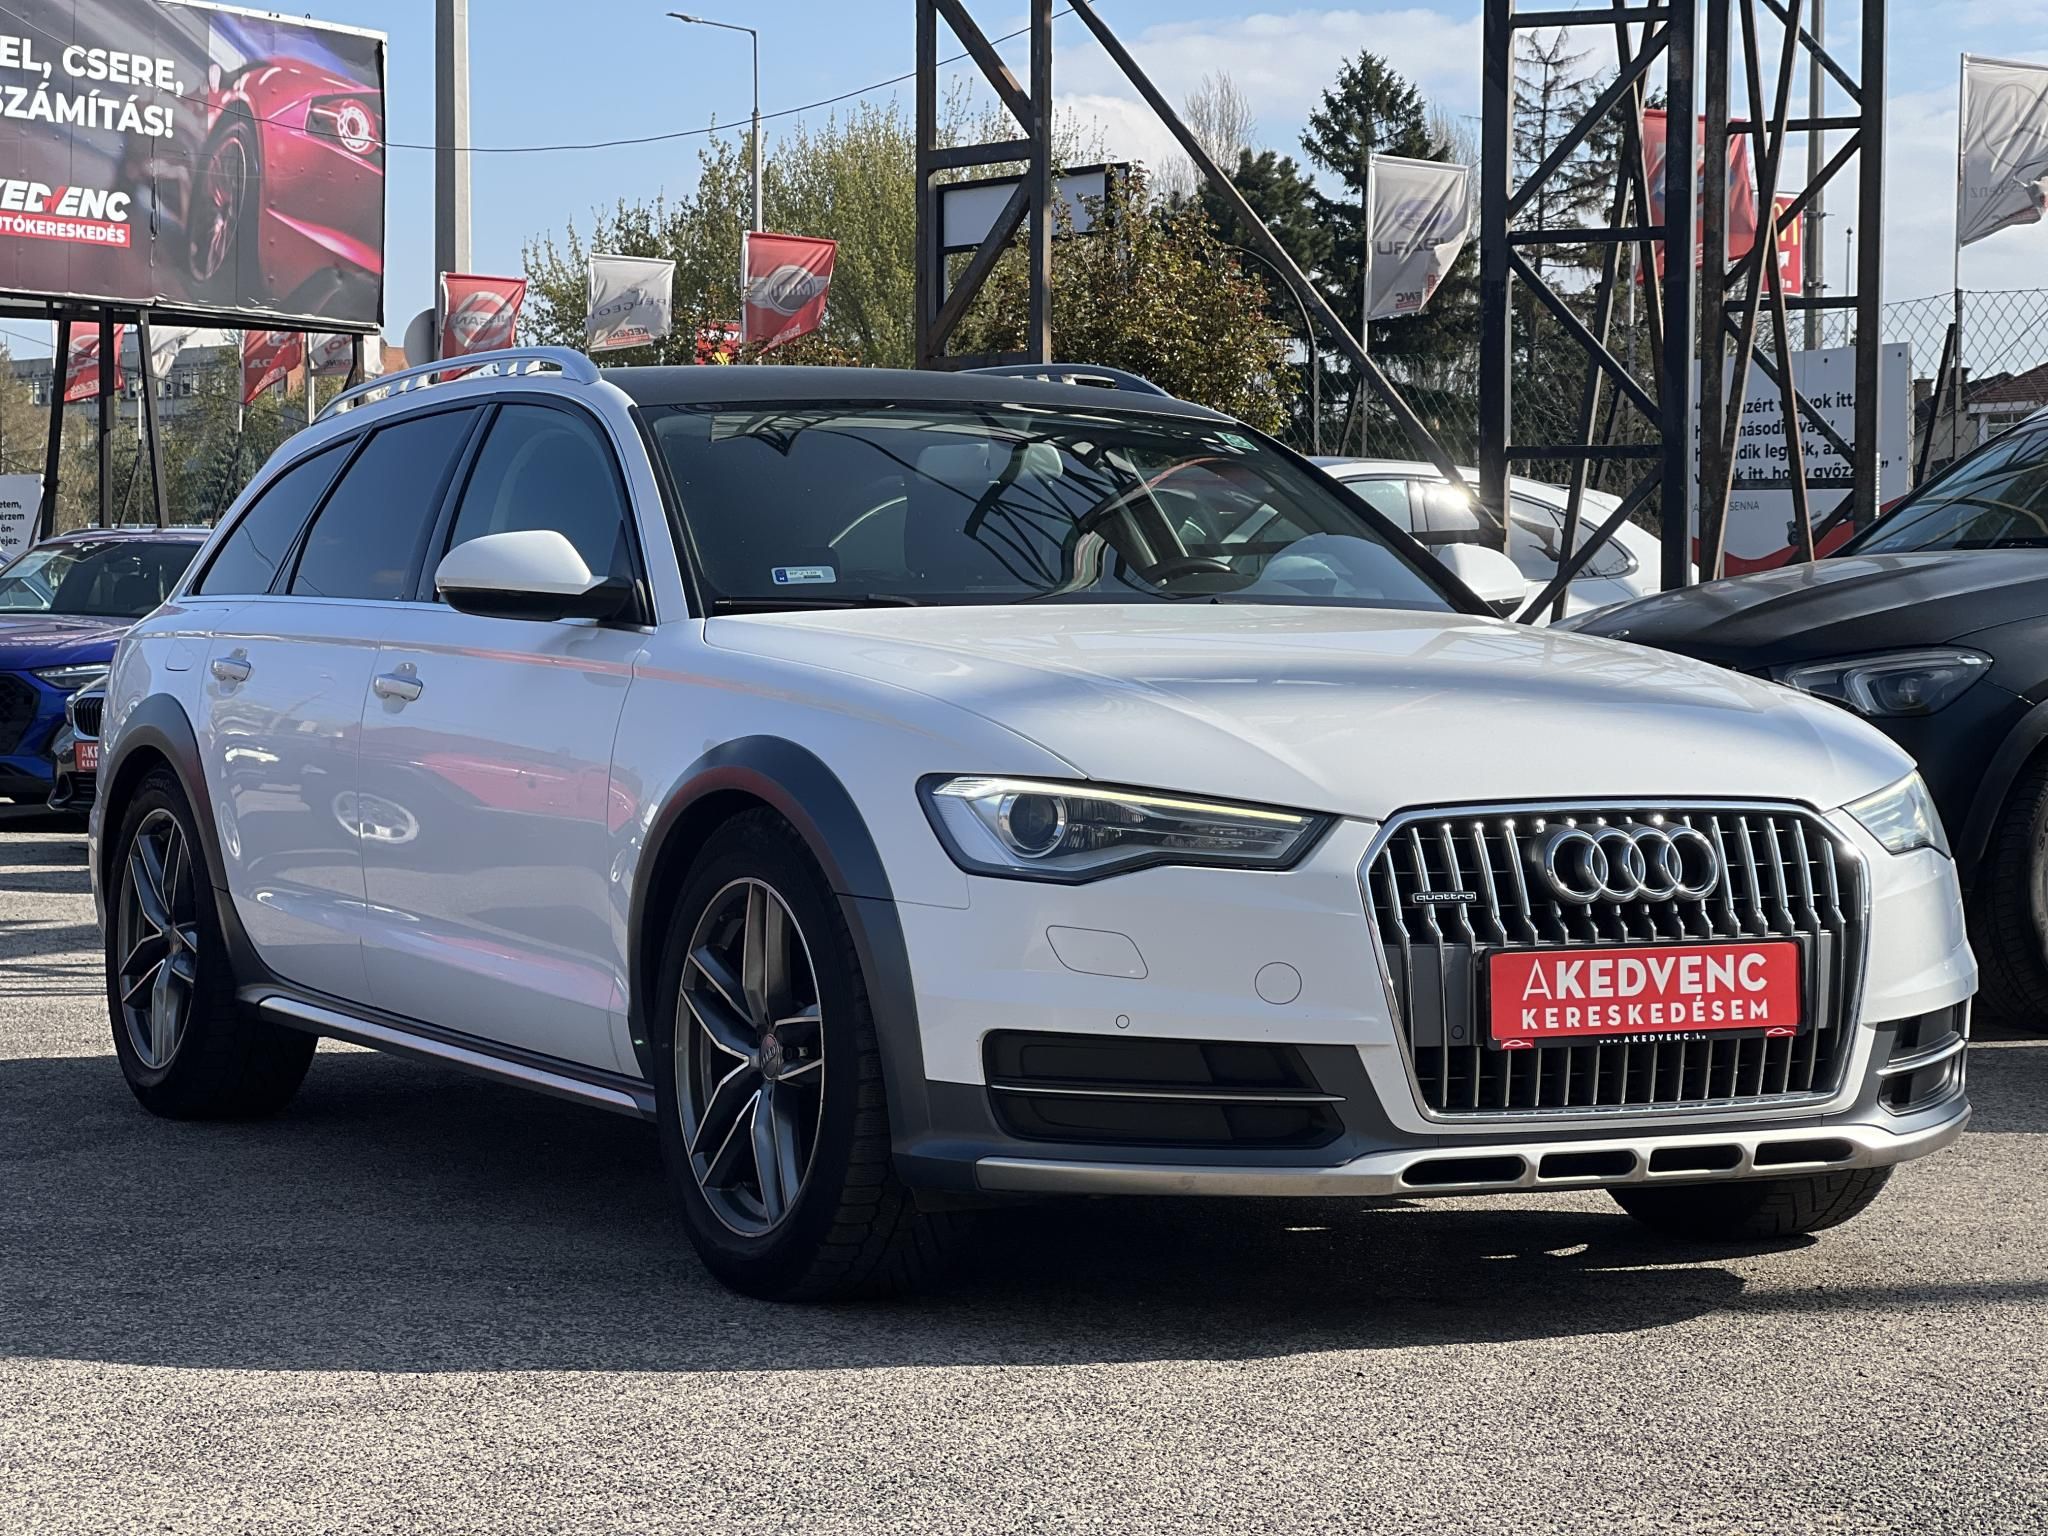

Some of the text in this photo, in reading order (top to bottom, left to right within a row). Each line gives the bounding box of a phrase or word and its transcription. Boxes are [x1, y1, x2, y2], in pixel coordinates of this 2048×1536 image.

[62, 45, 184, 98] CSERE,
[0, 82, 174, 139] ZÁMÍTÁS!
[0, 178, 131, 222] EDVENC
[0, 214, 126, 243] TÓKERESKEDÉS
[1740, 420, 1785, 436] ásodi
[1765, 442, 1819, 460] legk,
[1729, 501, 1760, 512] SENNA
[0, 536, 20, 547] ejez-
[1416, 893, 1474, 903] quattro
[1522, 994, 1769, 1030] KERESKEDÉSEM
[1599, 1032, 1706, 1044] www.AKEDVENC.hu
